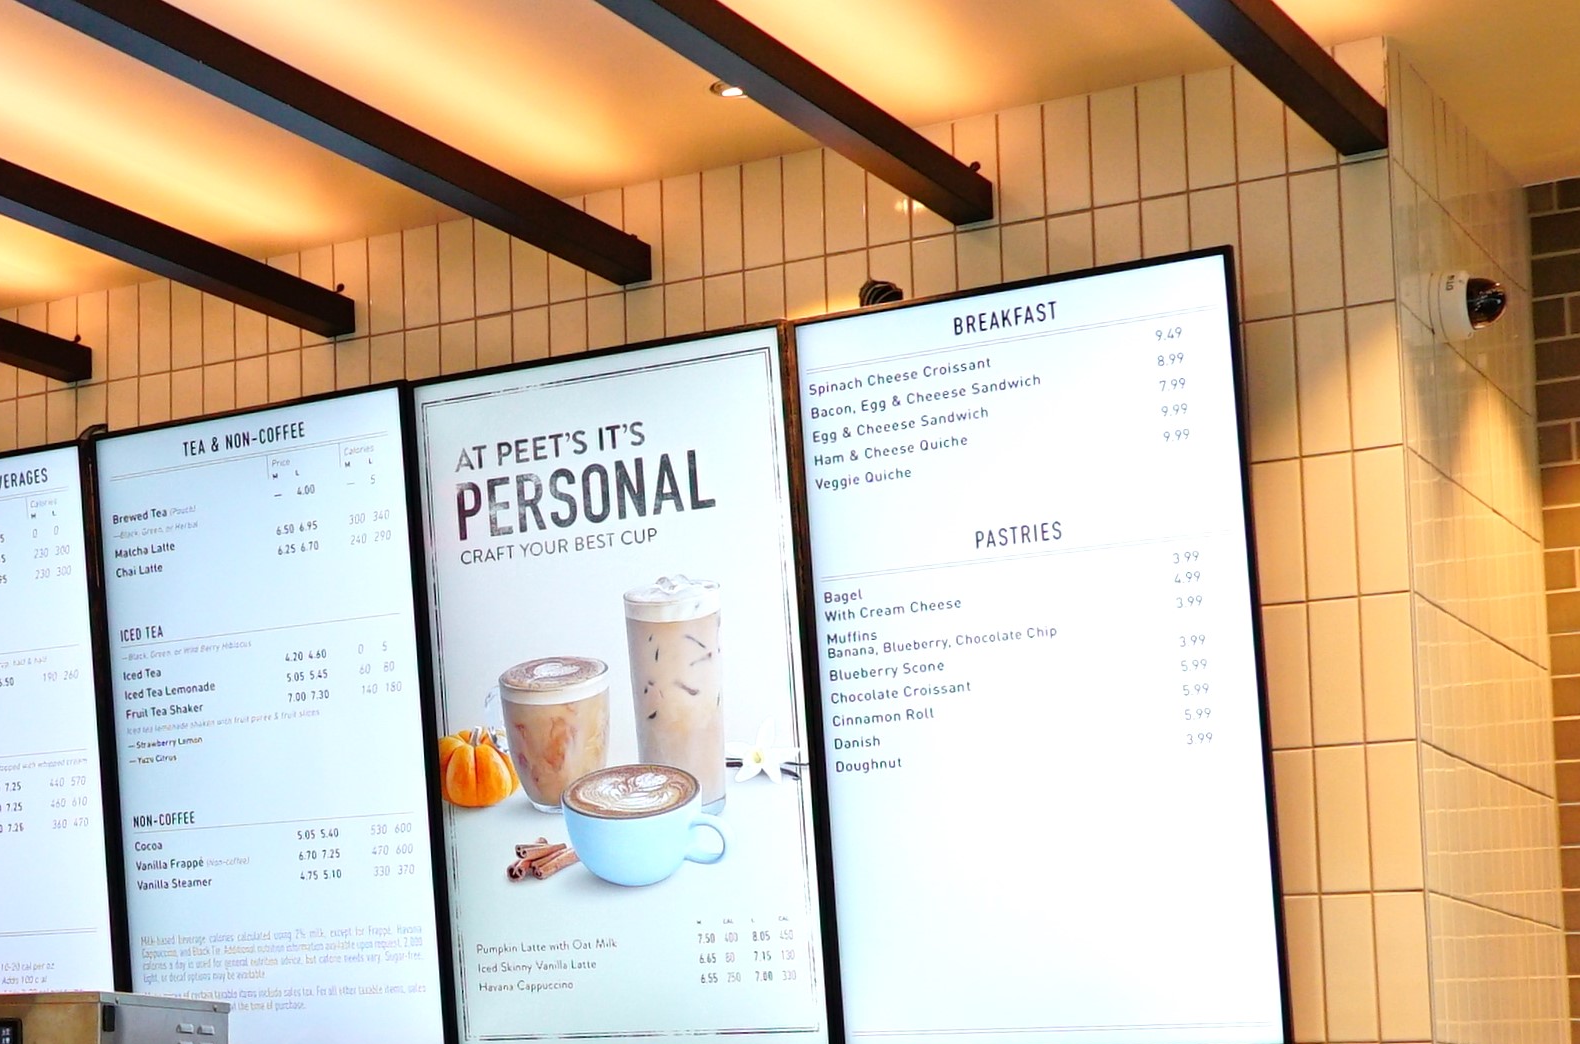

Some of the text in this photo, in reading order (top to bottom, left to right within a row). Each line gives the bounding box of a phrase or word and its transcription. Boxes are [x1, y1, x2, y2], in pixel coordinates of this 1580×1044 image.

[953, 301, 1056, 336] BREAKFAST
[1155, 327, 1182, 341] 9.49
[1157, 352, 1184, 367] 8.99
[809, 358, 991, 397] Spinach Cheese Croissant
[1159, 377, 1186, 391] 7.99
[811, 375, 1040, 419] Bacon, Egg & Cheeese Sandwich
[1161, 403, 1188, 417] 9.99
[812, 407, 988, 444] Egg & Cheeese Sandwich
[183, 421, 305, 456] TEA & NON-COFFEE
[1163, 428, 1190, 442] 9.99
[455, 422, 645, 472] AT PEET'S IT'S
[814, 436, 967, 466] Ham & Cheese Quiche
[815, 468, 911, 491] Veggie Quiche
[455, 448, 716, 542] PERSONAL
[112, 508, 167, 525] Brewed Tea
[276, 520, 318, 536] 6.50 6.95
[975, 521, 1062, 549] PASTRIES
[115, 542, 175, 559] Matcha Latte
[460, 528, 657, 565] CRAFT YOUR BEST CUP
[1173, 551, 1199, 564] 3.99
[116, 564, 163, 578] Chai Latte
[1174, 571, 1200, 583] 4.99
[824, 589, 862, 605] Bagel
[1176, 595, 1203, 609] 3.99
[824, 600, 961, 622] With Cream Cheese
[120, 625, 163, 642] ICED TEA
[826, 631, 877, 645] Muffins
[1180, 634, 1206, 647] 3.99
[827, 627, 1057, 659] Banana, Blueberry, Chocolate Chip
[829, 662, 944, 682] Blueberry Scone
[1181, 659, 1207, 672] 5.99
[123, 668, 161, 681] Iced Tea
[124, 681, 215, 700] Iced Tea Lemonade
[831, 682, 970, 704] Chocolate Croissant
[1183, 683, 1209, 696] 5.99
[126, 704, 203, 719] Fruit Tea Shaker
[832, 708, 934, 727] Cinnamon Roll
[1185, 708, 1211, 721] 5.99
[834, 736, 880, 750] Danish
[1187, 732, 1213, 745] 3.99
[835, 758, 901, 774] Doughnut
[133, 811, 195, 828] NON-COFFEE
[134, 841, 162, 852] Cocoa
[136, 856, 204, 871] Vanilla Frappé
[300, 869, 342, 880] 4.75 5.10
[137, 878, 212, 891] Vanilla Steamer
[476, 939, 617, 956] Pumpkin Latte with Oat Milk
[478, 960, 596, 974] Iced Skinny Vanilla Latte
[517, 980, 573, 993] Cappuccino
